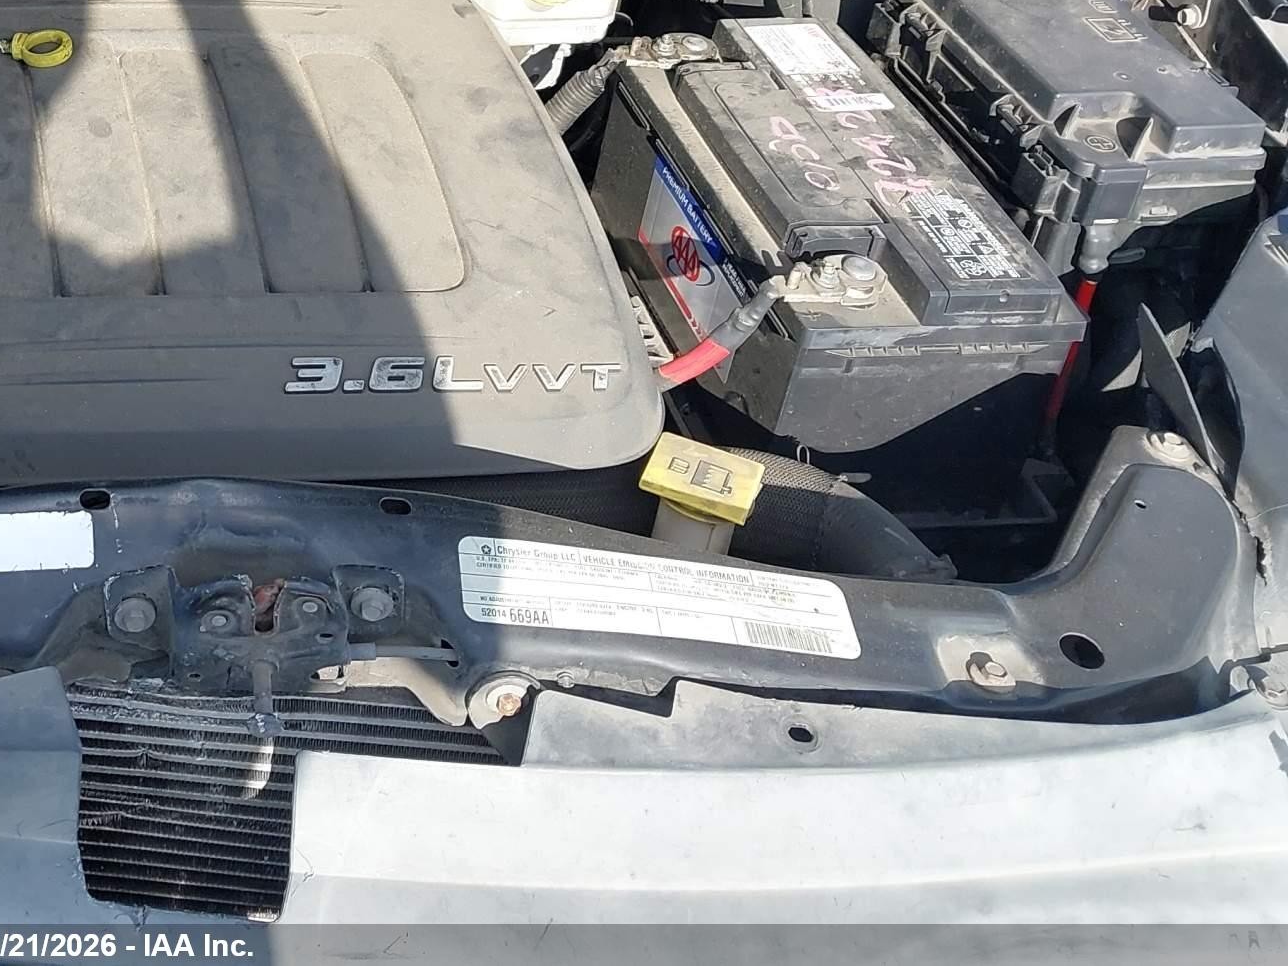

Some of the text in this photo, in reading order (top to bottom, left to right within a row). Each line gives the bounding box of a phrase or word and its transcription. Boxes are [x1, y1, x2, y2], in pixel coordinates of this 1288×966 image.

[662, 167, 713, 243] PREMIUM BATTERY
[496, 545, 577, 561] Chrysler Group LLC
[583, 555, 615, 566] VEHICLE
[657, 564, 695, 576] CONTROL
[695, 570, 751, 584] INFORMATION
[481, 607, 507, 618] 52014
[509, 608, 550, 625] 669AA
